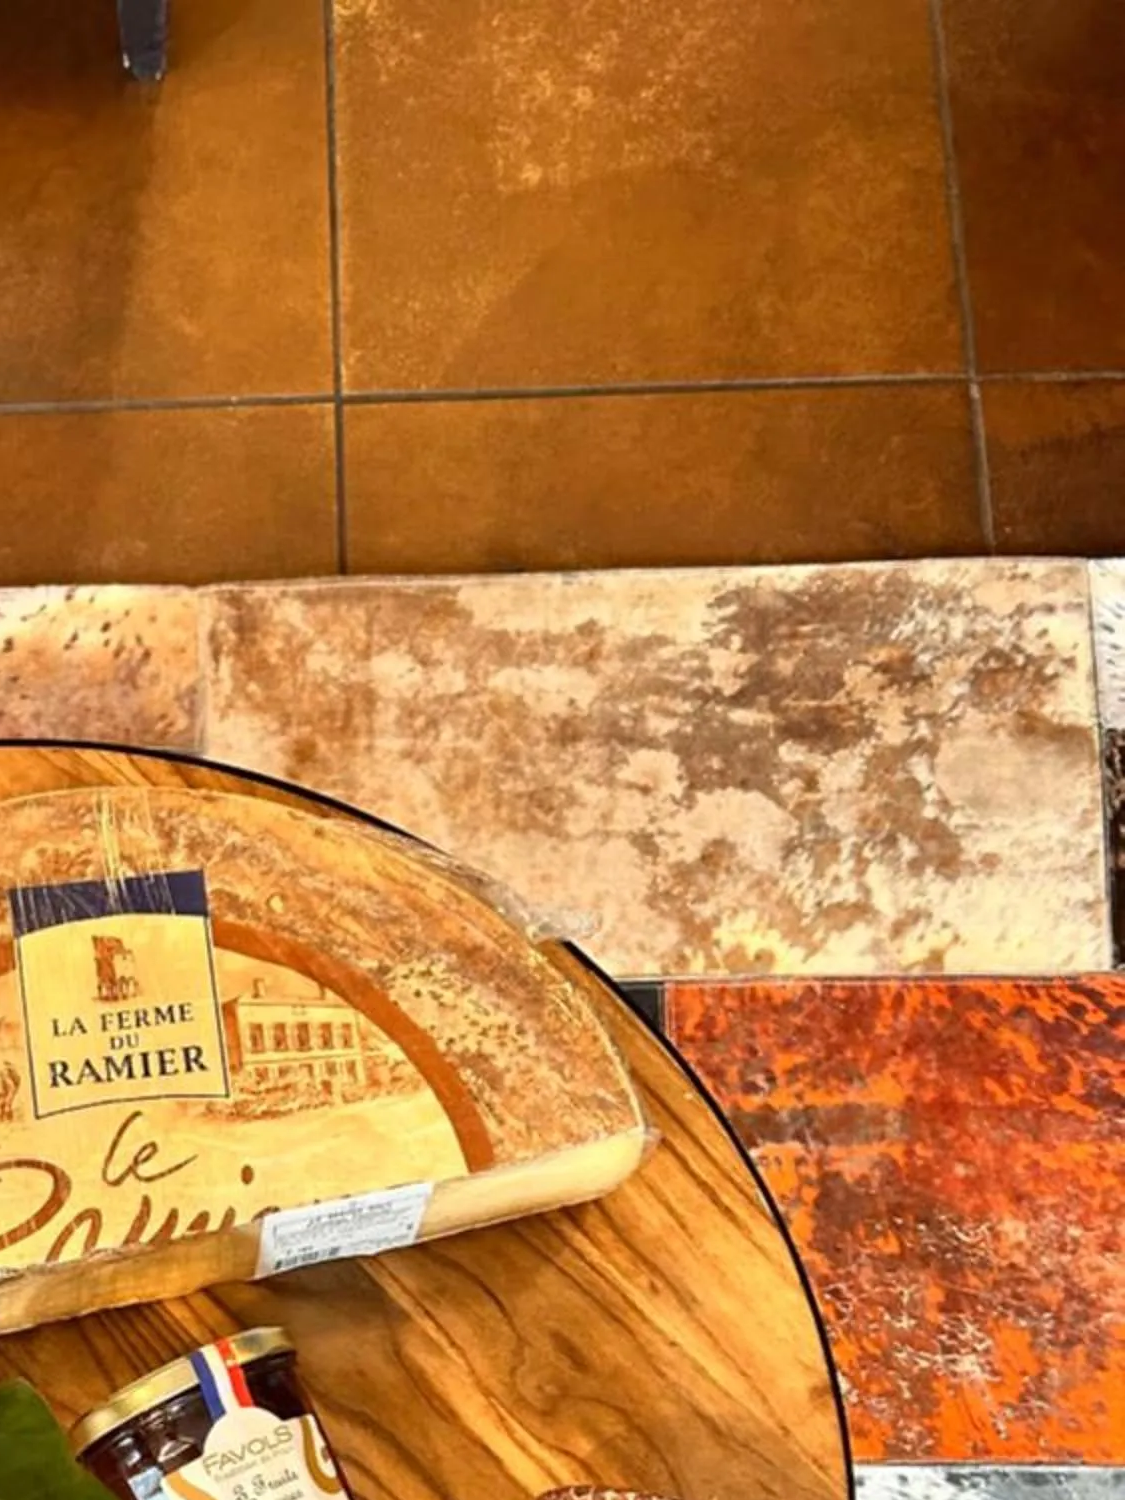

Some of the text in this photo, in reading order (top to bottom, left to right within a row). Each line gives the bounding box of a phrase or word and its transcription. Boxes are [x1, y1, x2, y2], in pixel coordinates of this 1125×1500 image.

[52, 1002, 194, 1037] LA FERME
[110, 1033, 140, 1051] DU
[48, 1045, 209, 1088] RAMIER
[203, 1425, 293, 1476] FAVOLS
